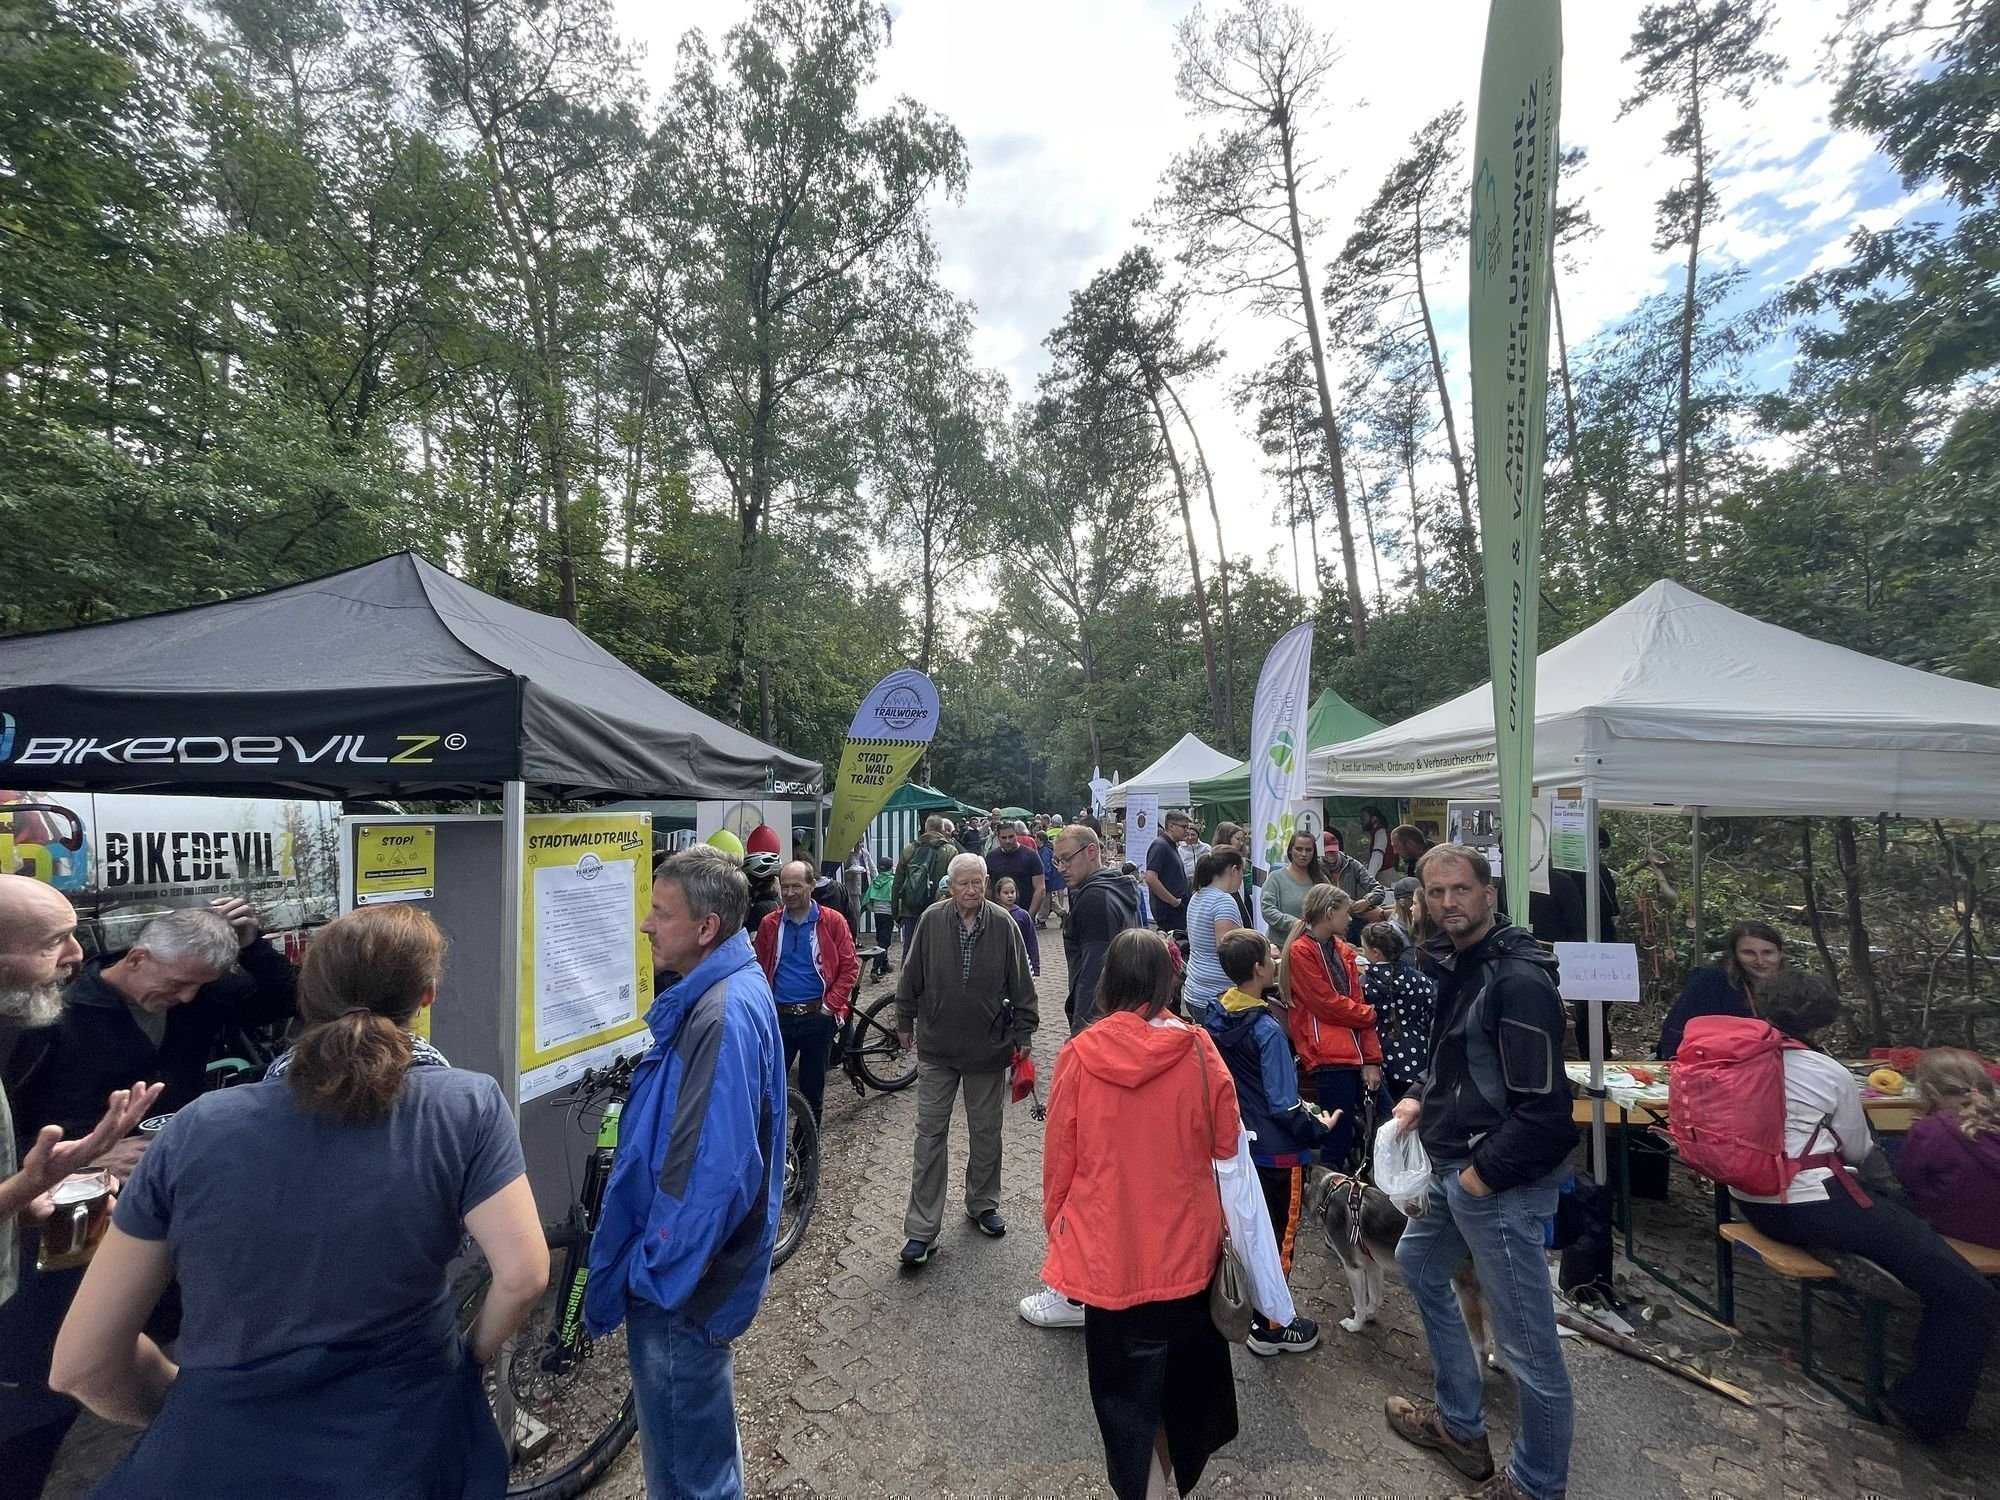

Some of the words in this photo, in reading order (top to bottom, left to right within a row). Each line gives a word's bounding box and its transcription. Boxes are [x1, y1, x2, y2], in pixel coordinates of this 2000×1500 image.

[1508, 97, 1526, 305] Umwelt,
[1513, 78, 1538, 521] Verbraucherschutz
[1506, 322, 1517, 385] für
[1505, 399, 1515, 487] Amt
[1511, 537, 1521, 566] &
[1509, 579, 1521, 733] Ordnung
[874, 708, 929, 719] TRAILWORKS
[857, 752, 890, 763] STADT
[865, 764, 894, 775] WALD
[1387, 761, 1415, 774] Ordnung
[1416, 759, 1423, 770] &
[1423, 752, 1496, 769] Verbraucherschutz
[851, 774, 885, 786] TRAILS
[381, 836, 414, 846] STOP!
[528, 830, 638, 849] STADTWALDTRAILS
[105, 831, 295, 887] BIKEDEVILZ
